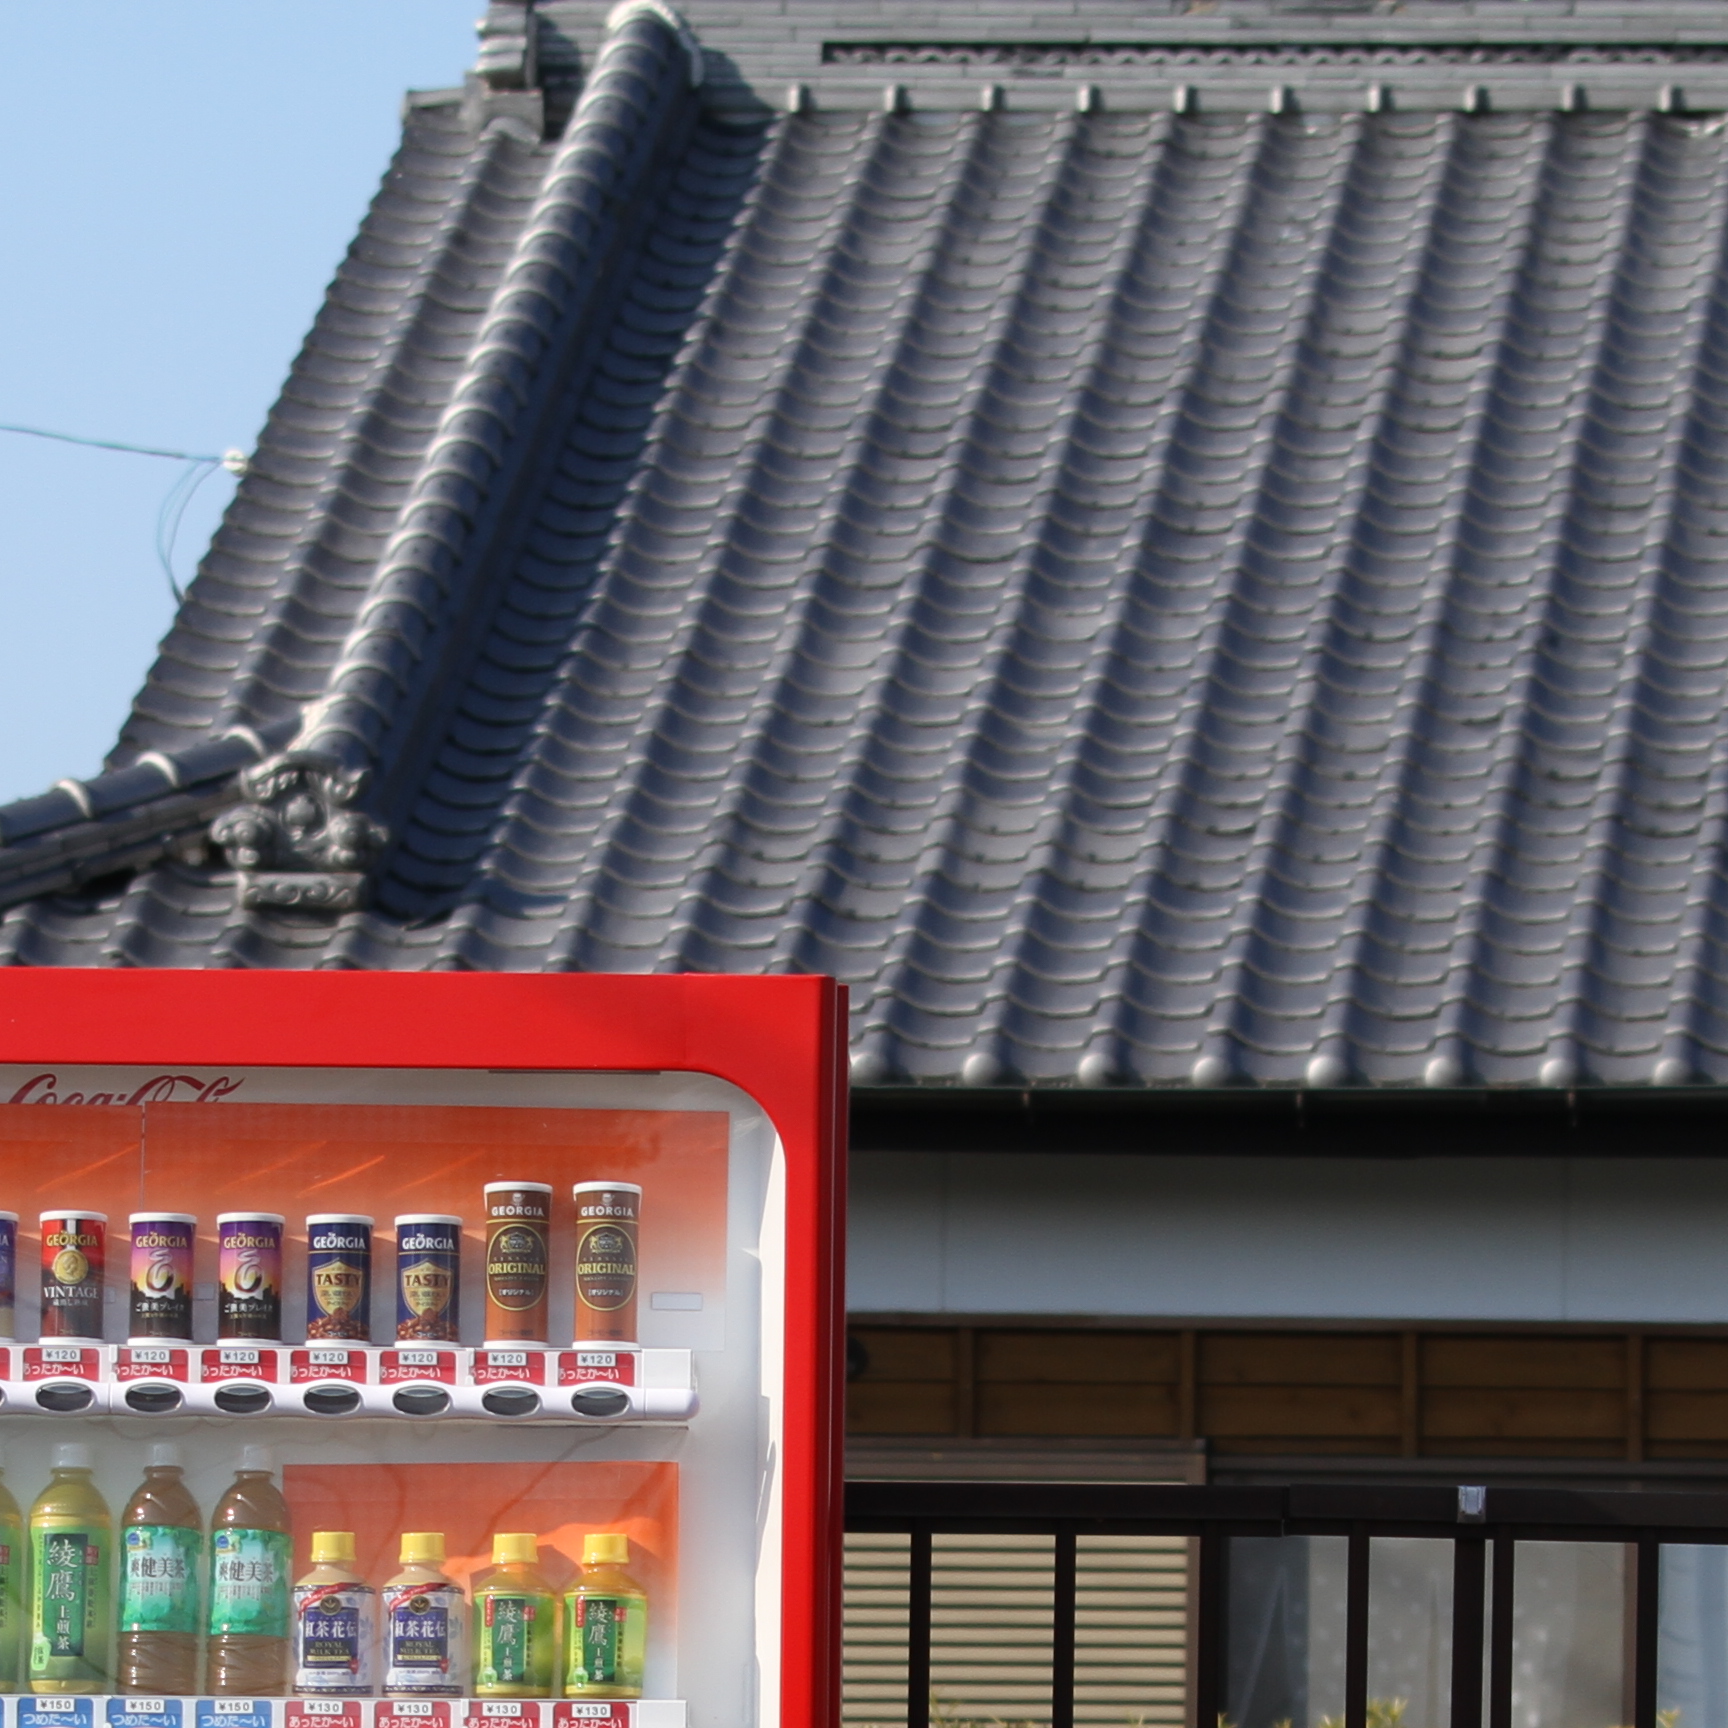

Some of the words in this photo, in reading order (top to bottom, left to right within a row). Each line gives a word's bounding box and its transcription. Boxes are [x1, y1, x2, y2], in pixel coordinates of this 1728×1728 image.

[491, 1206, 545, 1217] GEORGIA
[580, 1207, 634, 1218] GEORGIA
[488, 1262, 546, 1275] ORIGINAL
[577, 1262, 636, 1275] ORIGINAL
[315, 1273, 362, 1286] TASTY
[404, 1274, 451, 1287] TASTY
[43, 1286, 99, 1298] VINTAGE
[45, 1350, 78, 1360] ¥120
[134, 1351, 167, 1361] ¥120
[223, 1351, 256, 1361] ¥120
[312, 1352, 345, 1362] ¥120
[401, 1353, 434, 1363] ¥120
[491, 1354, 523, 1364] ¥120
[580, 1354, 613, 1364] ¥120
[45, 1538, 78, 1601] 綾鷹
[130, 1556, 185, 1579] 爽健美茶
[218, 1560, 274, 1582] 爽健美茶
[39, 1700, 72, 1710] ¥150
[129, 1701, 162, 1711] ¥150
[218, 1702, 250, 1712] ¥150
[307, 1702, 340, 1712] ¥130
[397, 1704, 429, 1713] ¥130
[486, 1704, 518, 1714] ¥130
[575, 1706, 608, 1716] ¥130
